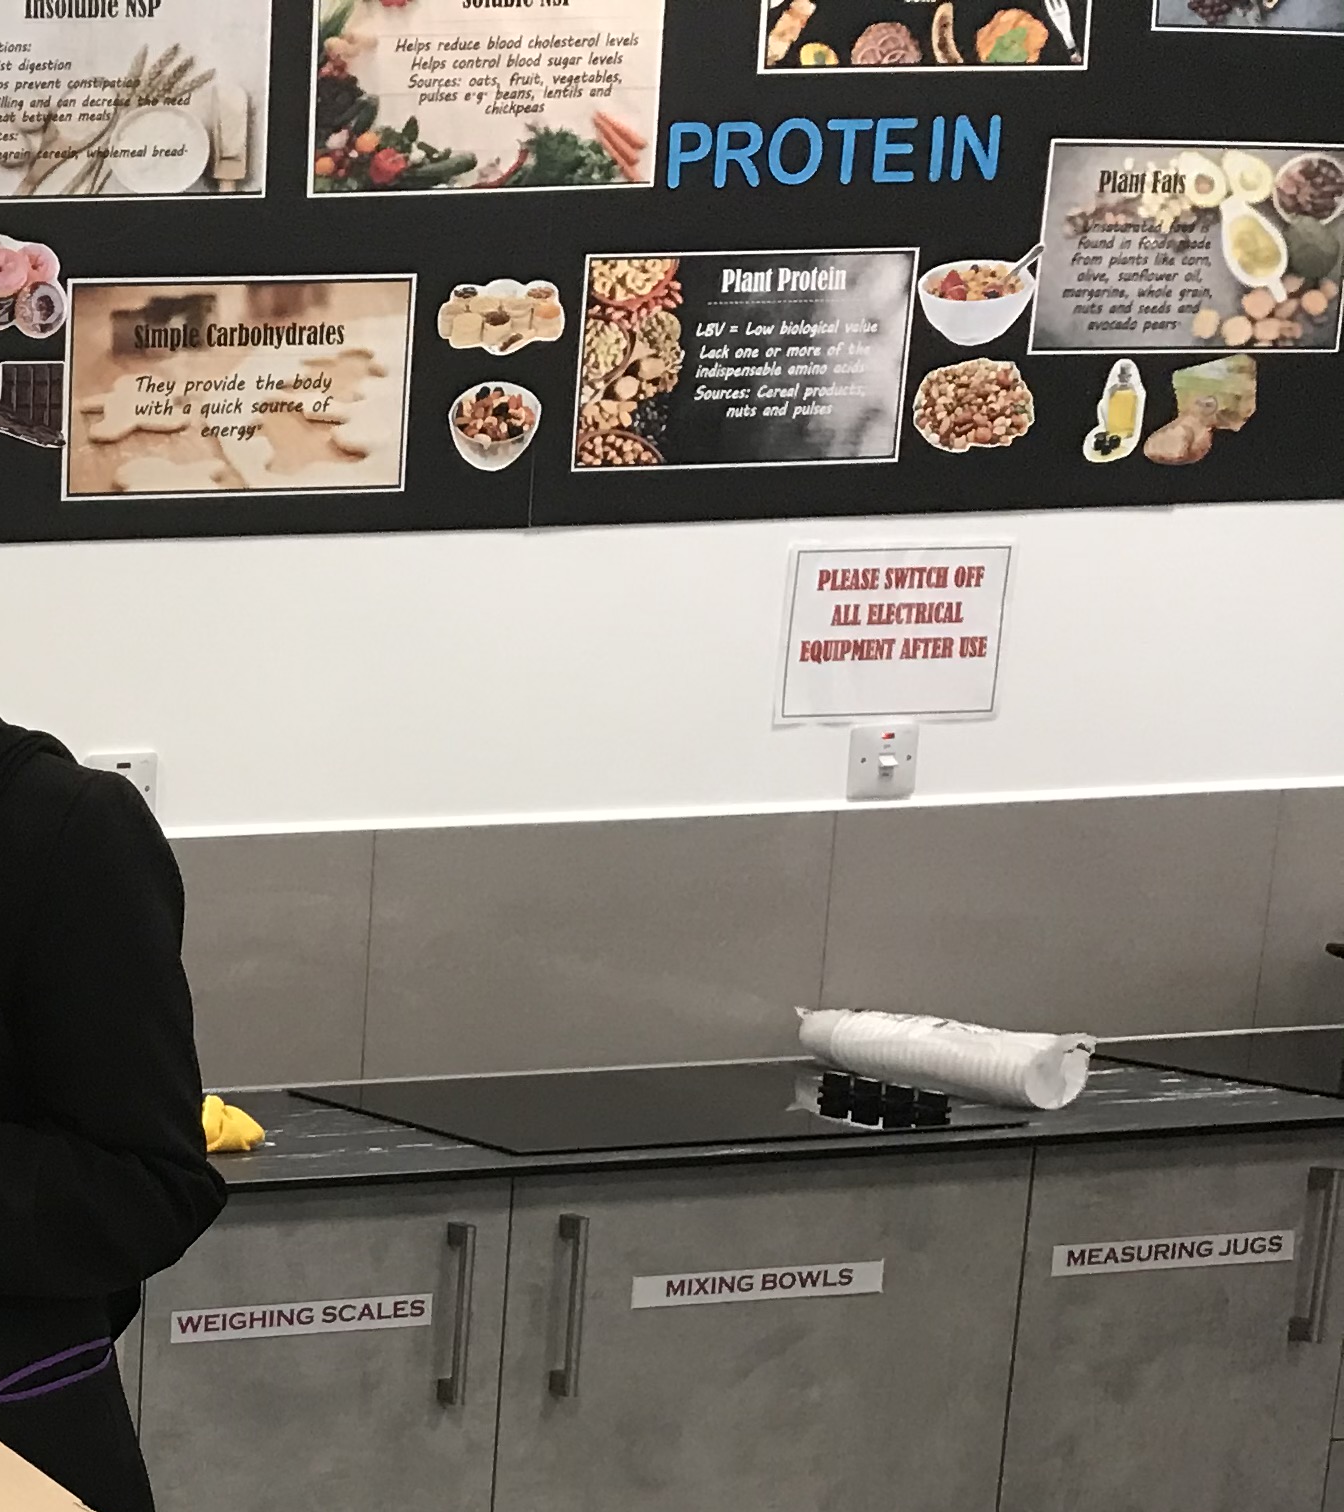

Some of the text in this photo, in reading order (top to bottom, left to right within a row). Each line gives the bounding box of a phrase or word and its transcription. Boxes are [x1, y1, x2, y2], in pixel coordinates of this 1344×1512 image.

[25, 0, 162, 18] Insoluble NSP
[396, 33, 638, 53] Helps reduce blood cholesterol levels
[18, 60, 71, 72] digestion
[412, 51, 623, 72] Helps control blood sugar levels
[14, 79, 60, 91] prevent
[68, 78, 140, 90] constipation
[409, 70, 622, 88] Sources: oats, fruit, vegetables,
[30, 96, 50, 107] and
[57, 97, 76, 108] can
[83, 96, 130, 107] decrease
[164, 94, 190, 105] need
[419, 89, 457, 105] pulses
[496, 86, 534, 101] beans,
[544, 84, 582, 99] lentils
[590, 84, 611, 97] and
[22, 111, 72, 123] between
[485, 101, 544, 116] chickpeas
[87, 145, 146, 158] wholemeal
[667, 114, 1002, 189] PROTEIN
[1100, 170, 1185, 193] Plant Fats
[1078, 236, 1114, 249] found
[1121, 238, 1131, 249] in
[1071, 252, 1211, 268] from plants like corn,
[722, 267, 846, 293] Plant Protein
[1118, 269, 1178, 282] sunflower
[1138, 285, 1172, 298] whole
[1179, 286, 1212, 300] grain,
[1073, 301, 1200, 314] nuts and seeds and
[696, 322, 726, 337] LBV
[746, 322, 774, 335] Low
[780, 319, 839, 337] biological
[845, 318, 877, 334] value
[1088, 317, 1137, 330] avocado
[134, 321, 344, 351] Simple Carbohydrates
[699, 345, 729, 359] Lack
[735, 348, 758, 358] one
[766, 348, 781, 358] or
[787, 346, 821, 357] more
[827, 342, 844, 356] of
[696, 360, 863, 380] indispensable amino acids
[136, 372, 331, 396] They provide the body
[694, 385, 750, 400] Sources:
[757, 383, 800, 398] Cereal
[136, 396, 333, 418] with a quick source of
[726, 401, 832, 419] nuts and pulses
[817, 566, 985, 590] PLEASE SWITCH OFF
[831, 601, 964, 626] ALL ELECTRICAL
[799, 636, 987, 664] EQUIPMENT AFTER USE
[1067, 1235, 1283, 1268] MEASURING JUGS
[664, 1267, 853, 1298] MIXING BOWLS
[177, 1300, 425, 1335] WEIGHING SCALES
